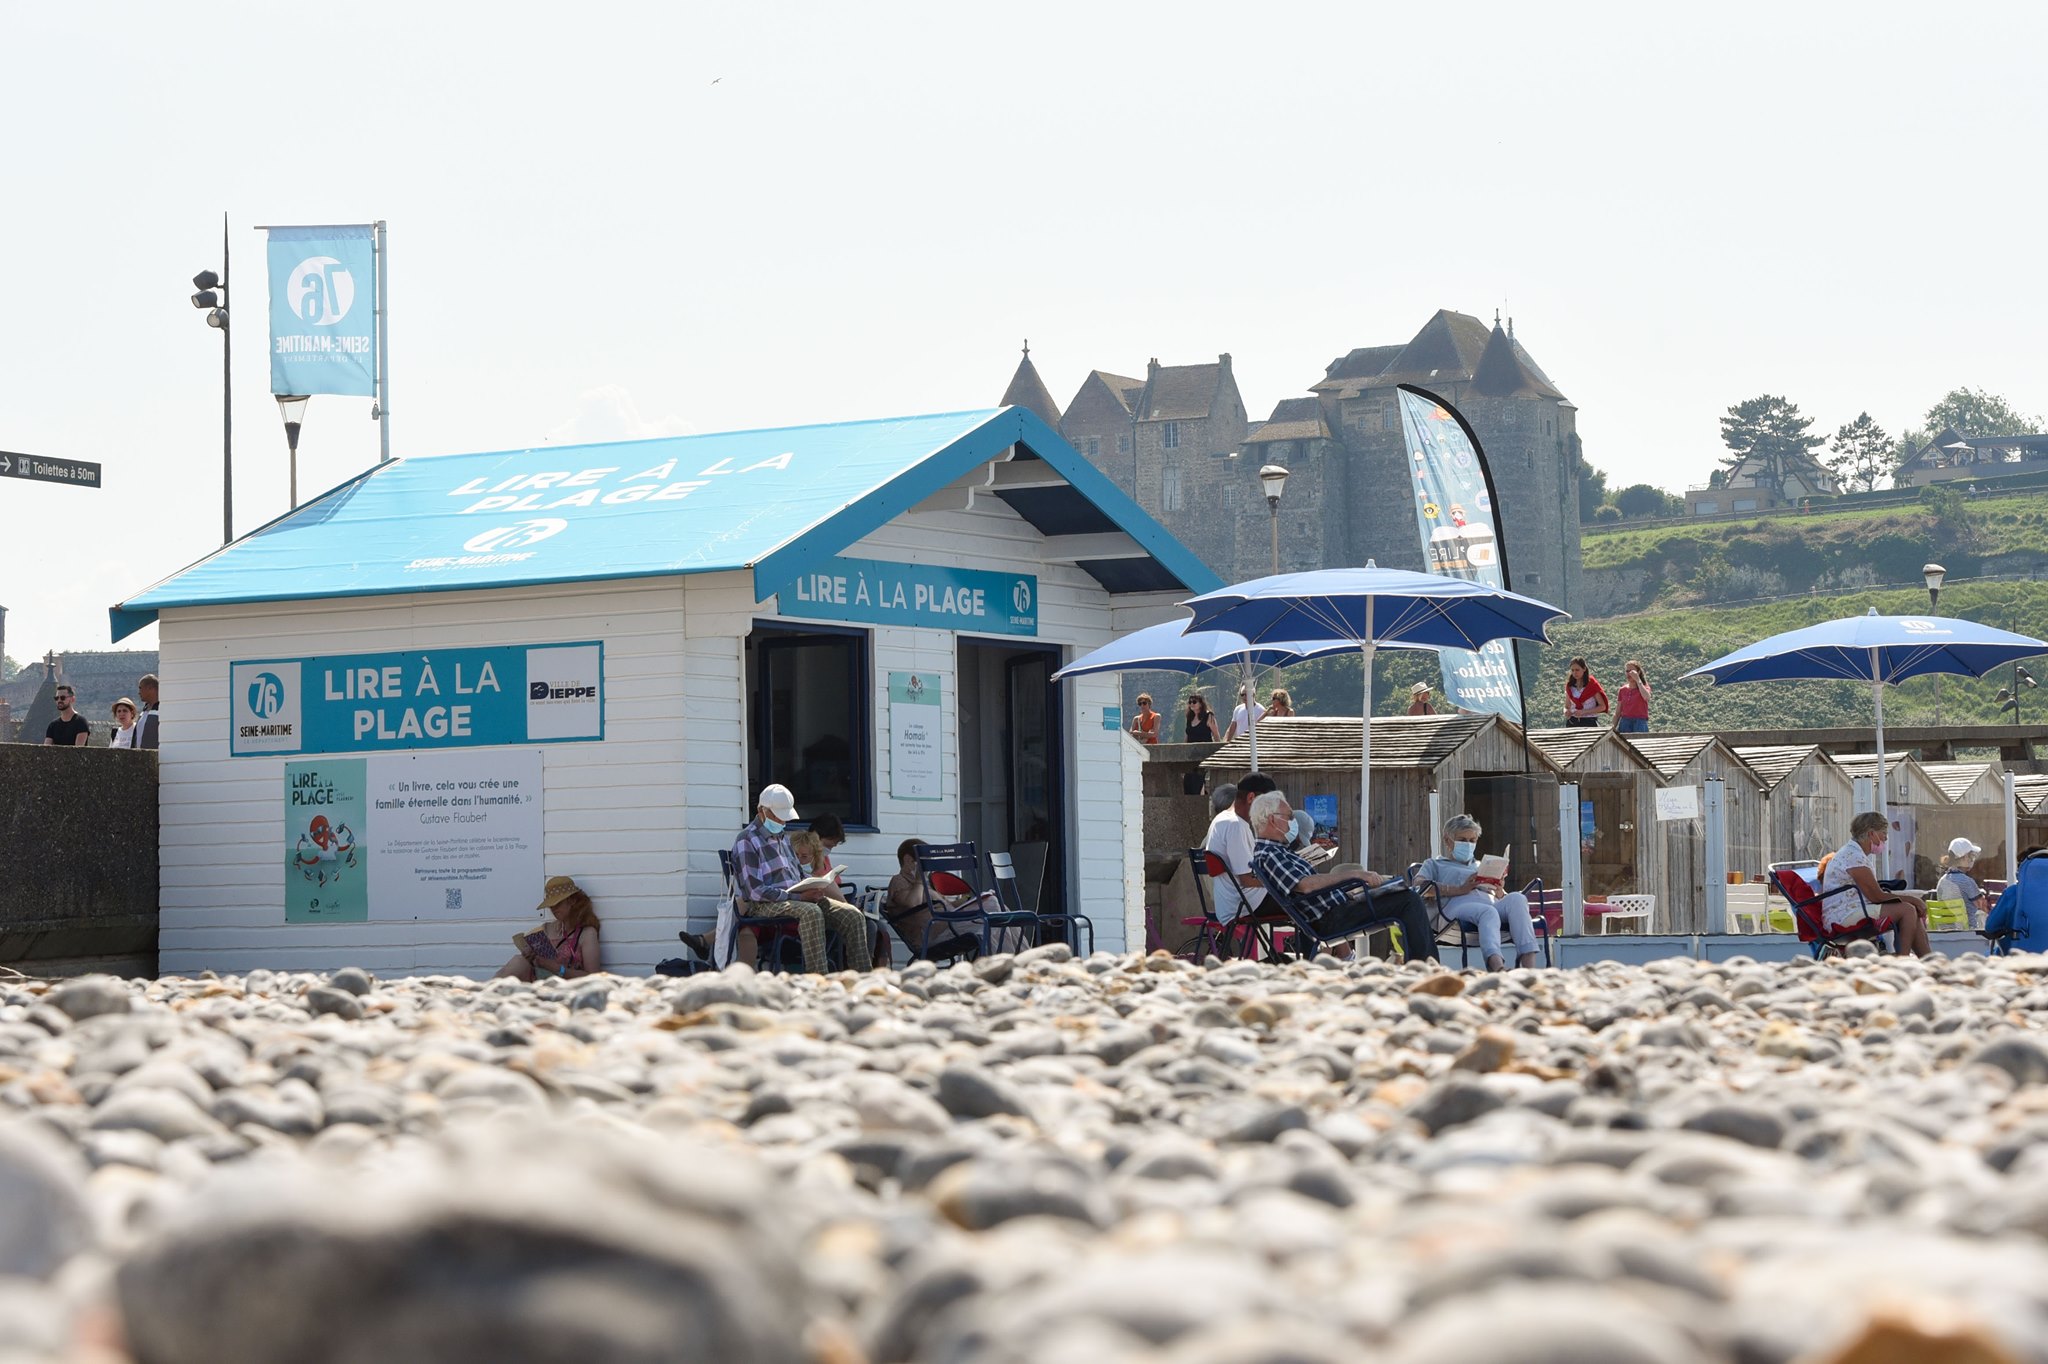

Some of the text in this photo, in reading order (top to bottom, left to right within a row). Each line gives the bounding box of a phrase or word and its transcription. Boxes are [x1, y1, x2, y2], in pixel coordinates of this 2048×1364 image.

[33, 462, 96, 481] Toilettes à 50m
[447, 452, 796, 497] LIRE À LA
[456, 479, 713, 515] PLAGE
[797, 572, 985, 616] LIRE À LA PLAGE
[1013, 582, 1029, 613] 76
[324, 656, 501, 701] LIRE À LA
[250, 676, 279, 719] 76
[530, 682, 596, 700] DIEPPE
[240, 724, 292, 737] SEINE-MARITIME
[354, 705, 472, 741] PLAGE
[292, 772, 318, 788] LIRE
[398, 782, 410, 792] Un
[412, 781, 433, 792] livre,
[435, 780, 455, 791] cela
[458, 781, 477, 790] vous
[479, 778, 500, 789] crée
[502, 780, 519, 789] une
[292, 788, 334, 806] PLAGE
[375, 797, 405, 809] famille
[408, 795, 449, 808] éternelle
[451, 796, 472, 807] dans
[419, 812, 488, 825] Gustave Flaubert
